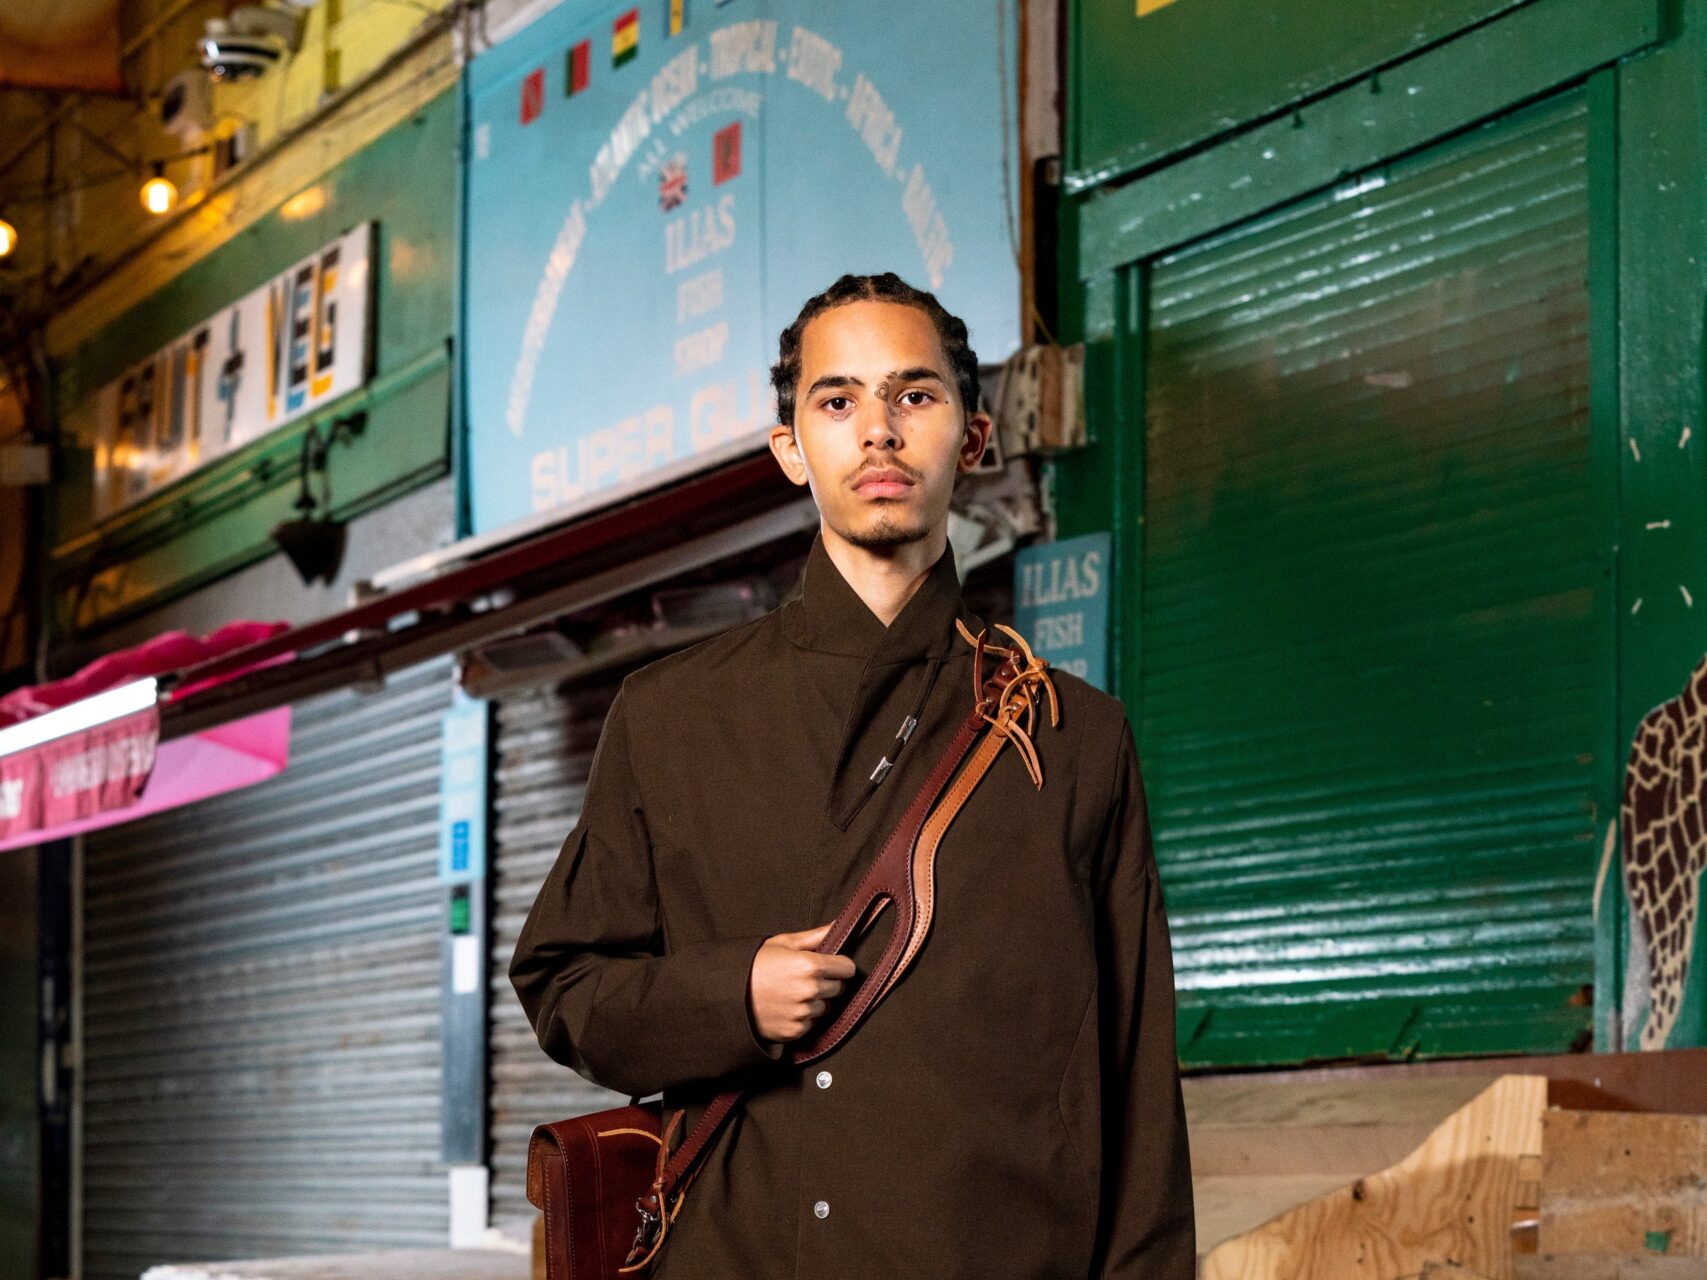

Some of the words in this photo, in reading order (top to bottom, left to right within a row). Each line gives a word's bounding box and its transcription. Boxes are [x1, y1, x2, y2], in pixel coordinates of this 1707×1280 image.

[665, 194, 736, 274] ILIAS
[530, 404, 676, 510] SUPER
[1021, 551, 1100, 608] ILIAS
[1034, 612, 1083, 656] FISH
